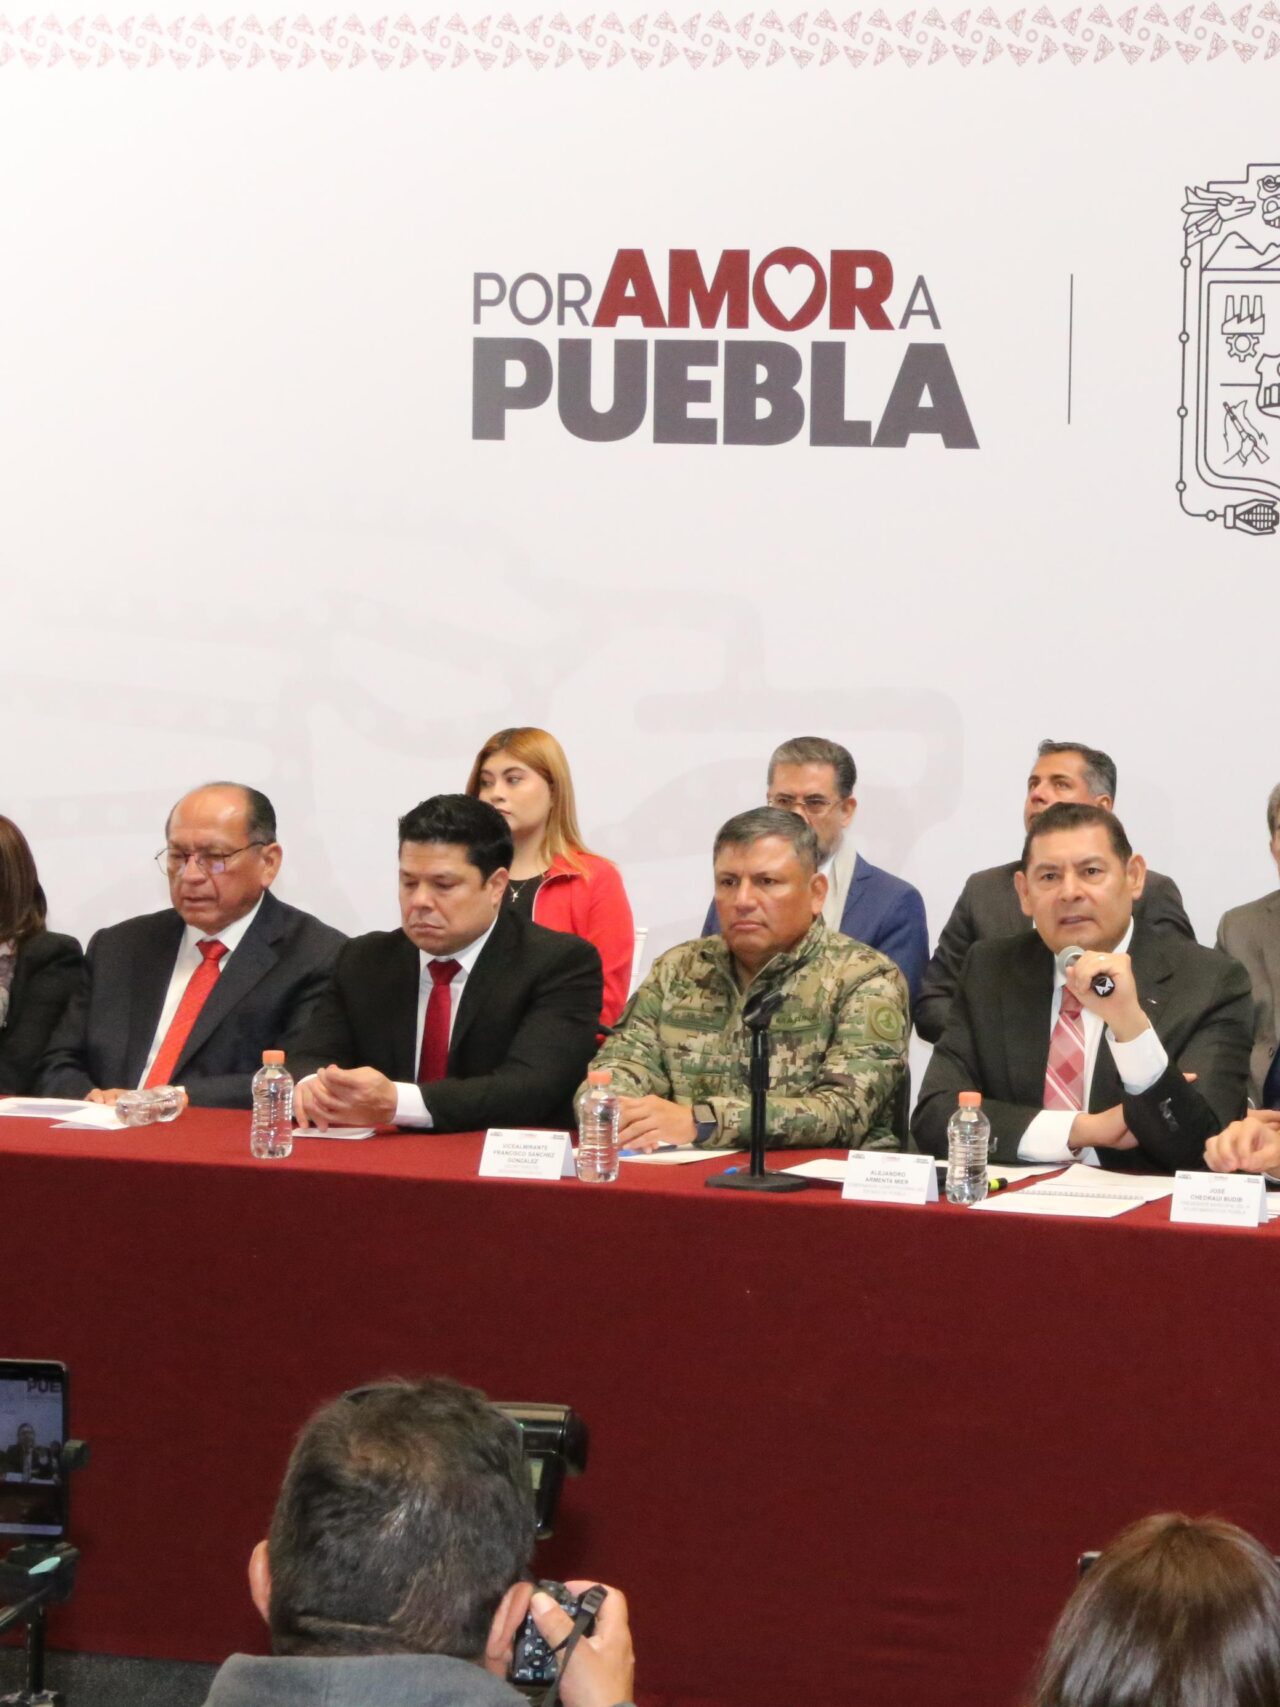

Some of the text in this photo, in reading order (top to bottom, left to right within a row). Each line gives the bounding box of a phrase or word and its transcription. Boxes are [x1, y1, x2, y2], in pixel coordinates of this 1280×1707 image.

[472, 246, 942, 332] POR AMOR A
[471, 337, 981, 450] PUEBLA
